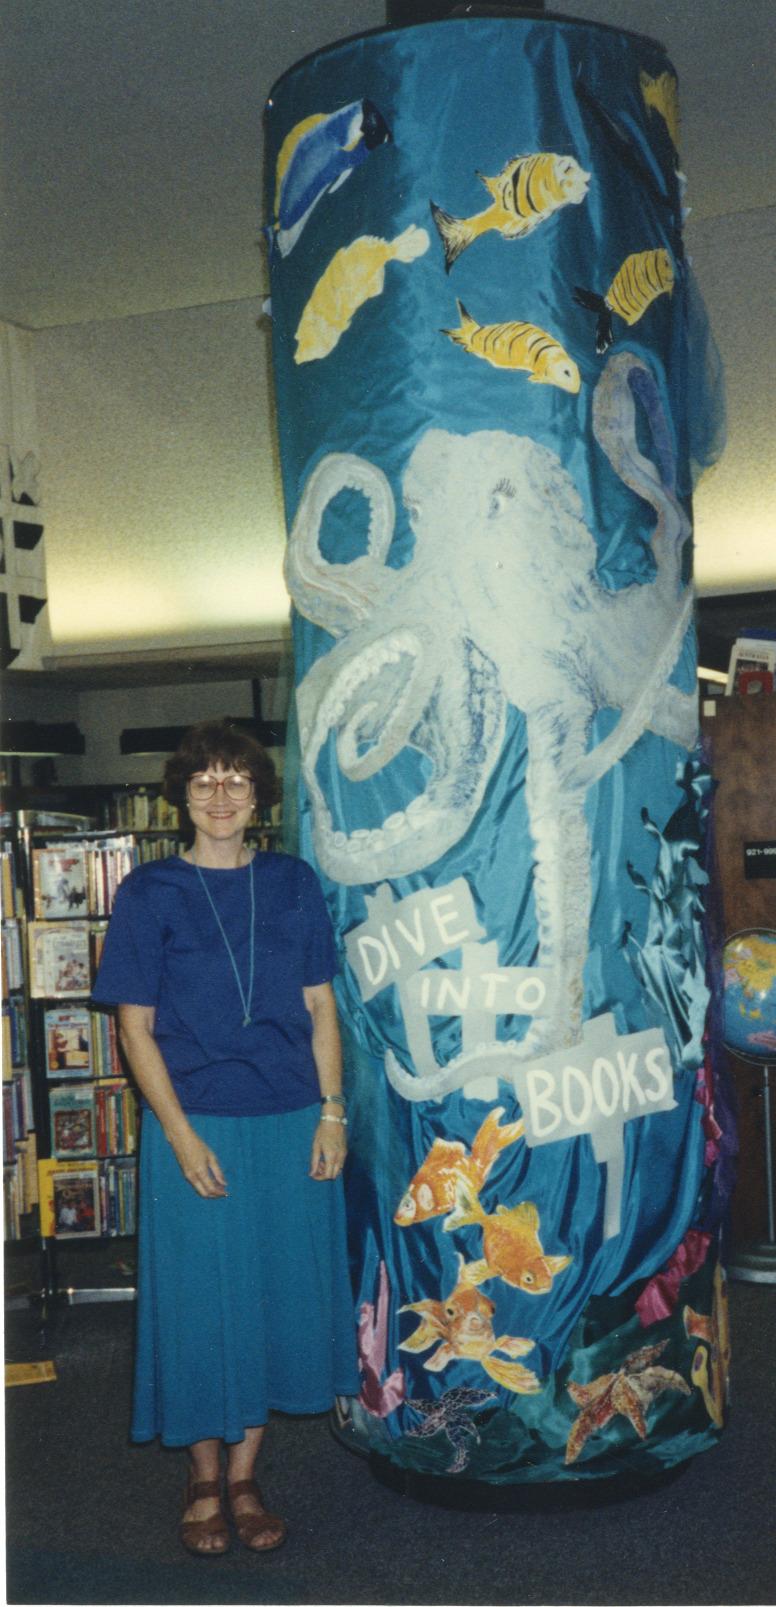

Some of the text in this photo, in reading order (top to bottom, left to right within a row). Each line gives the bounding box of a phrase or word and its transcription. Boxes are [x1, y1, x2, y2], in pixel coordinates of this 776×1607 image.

[357, 894, 470, 986] DIVE
[420, 973, 546, 1011] INTO
[525, 1046, 663, 1138] BOOKS
